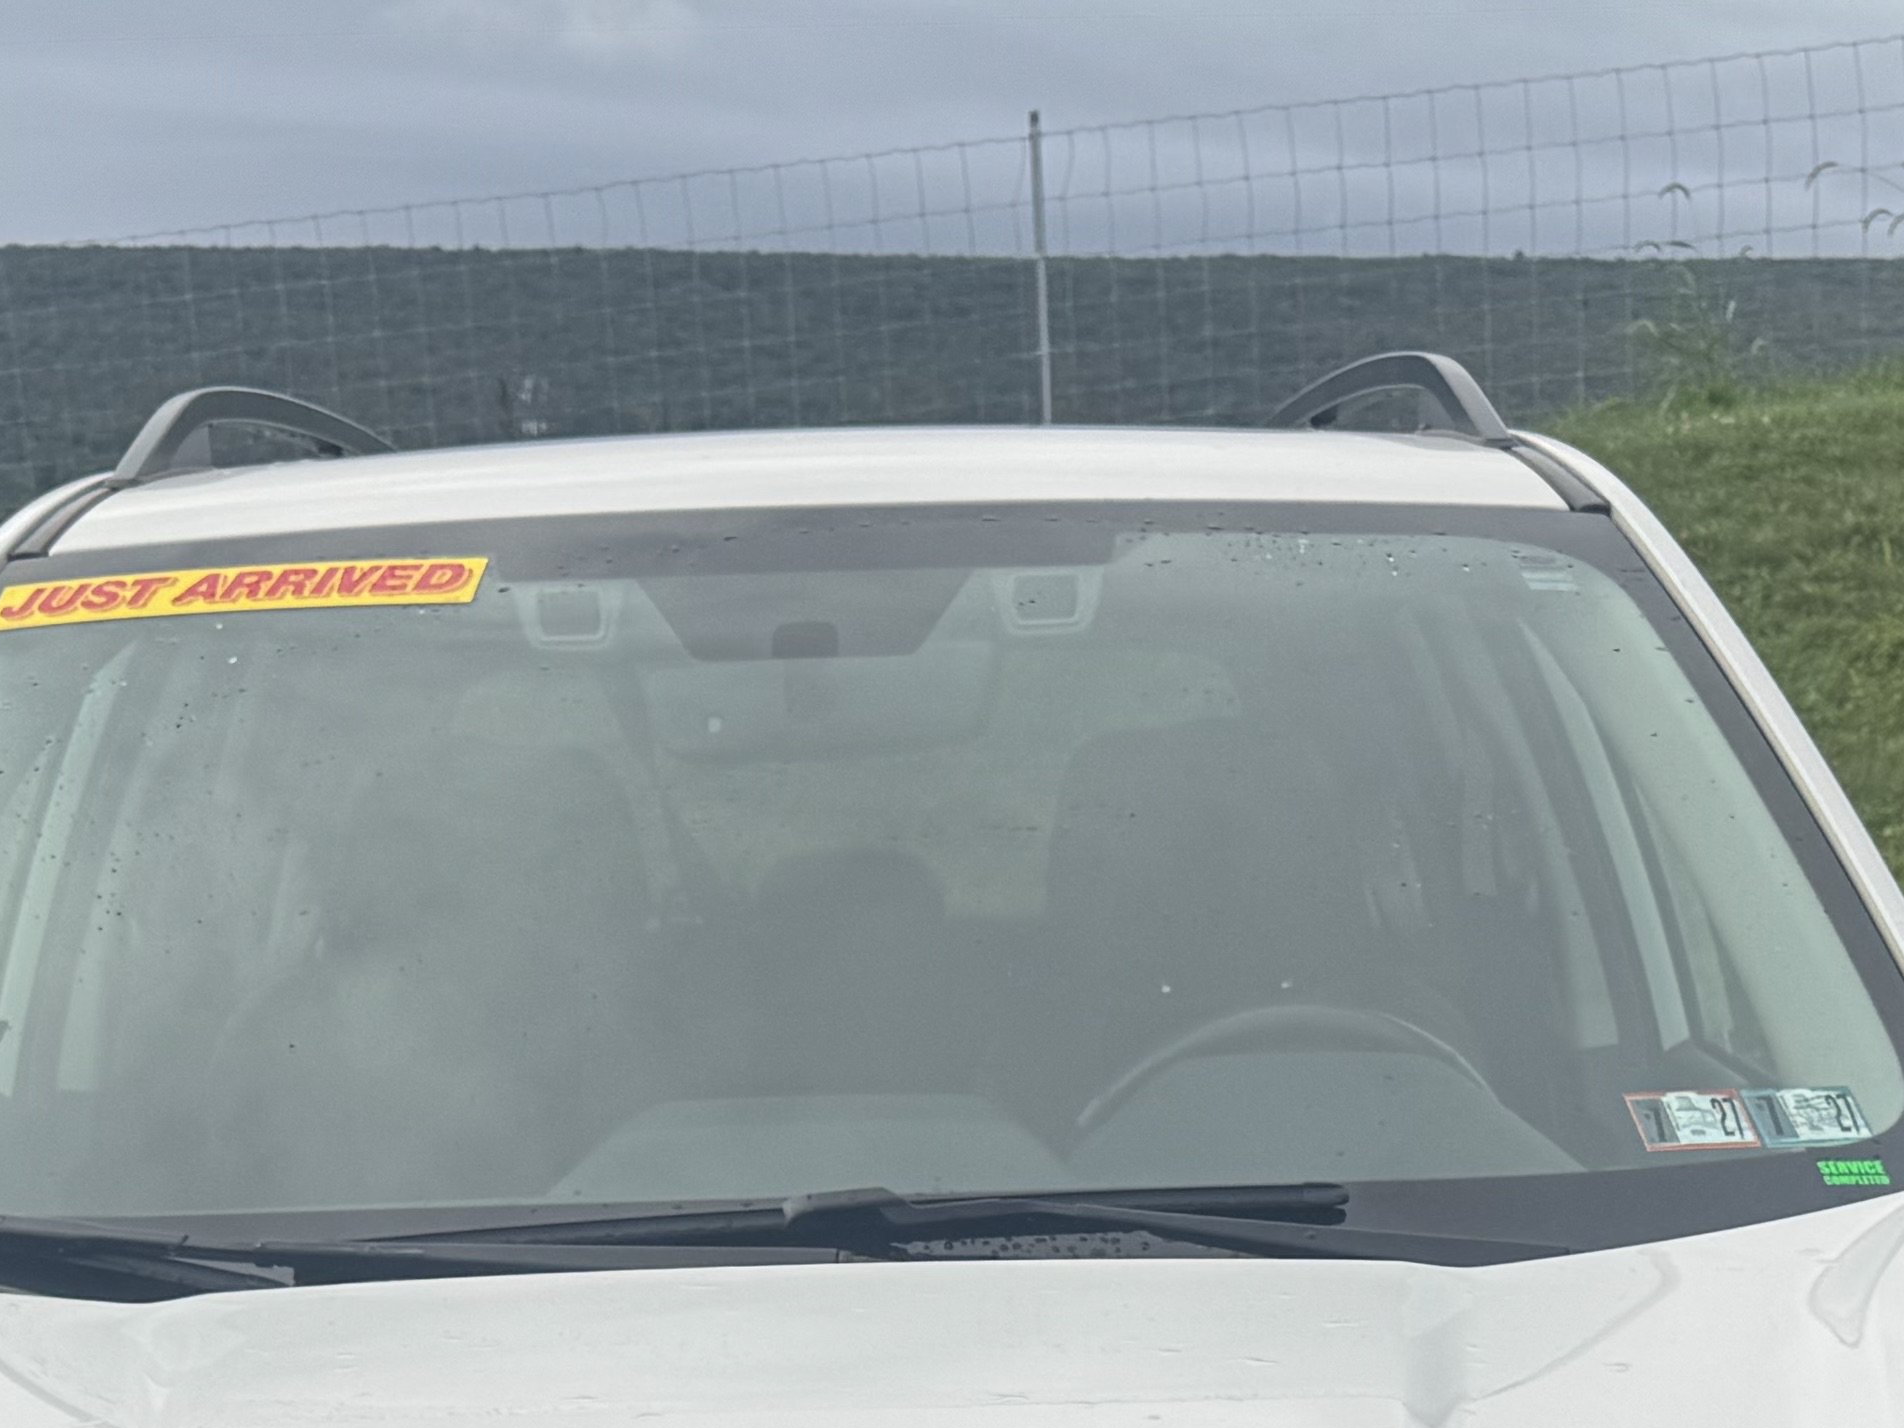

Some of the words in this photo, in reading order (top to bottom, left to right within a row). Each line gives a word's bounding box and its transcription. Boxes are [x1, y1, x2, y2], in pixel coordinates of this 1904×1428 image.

[0, 576, 178, 621] JUST
[172, 563, 473, 606] ARRIVED
[1710, 1098, 1745, 1140] 27
[1825, 1093, 1860, 1134] 27
[1816, 1160, 1884, 1174] SERVICE
